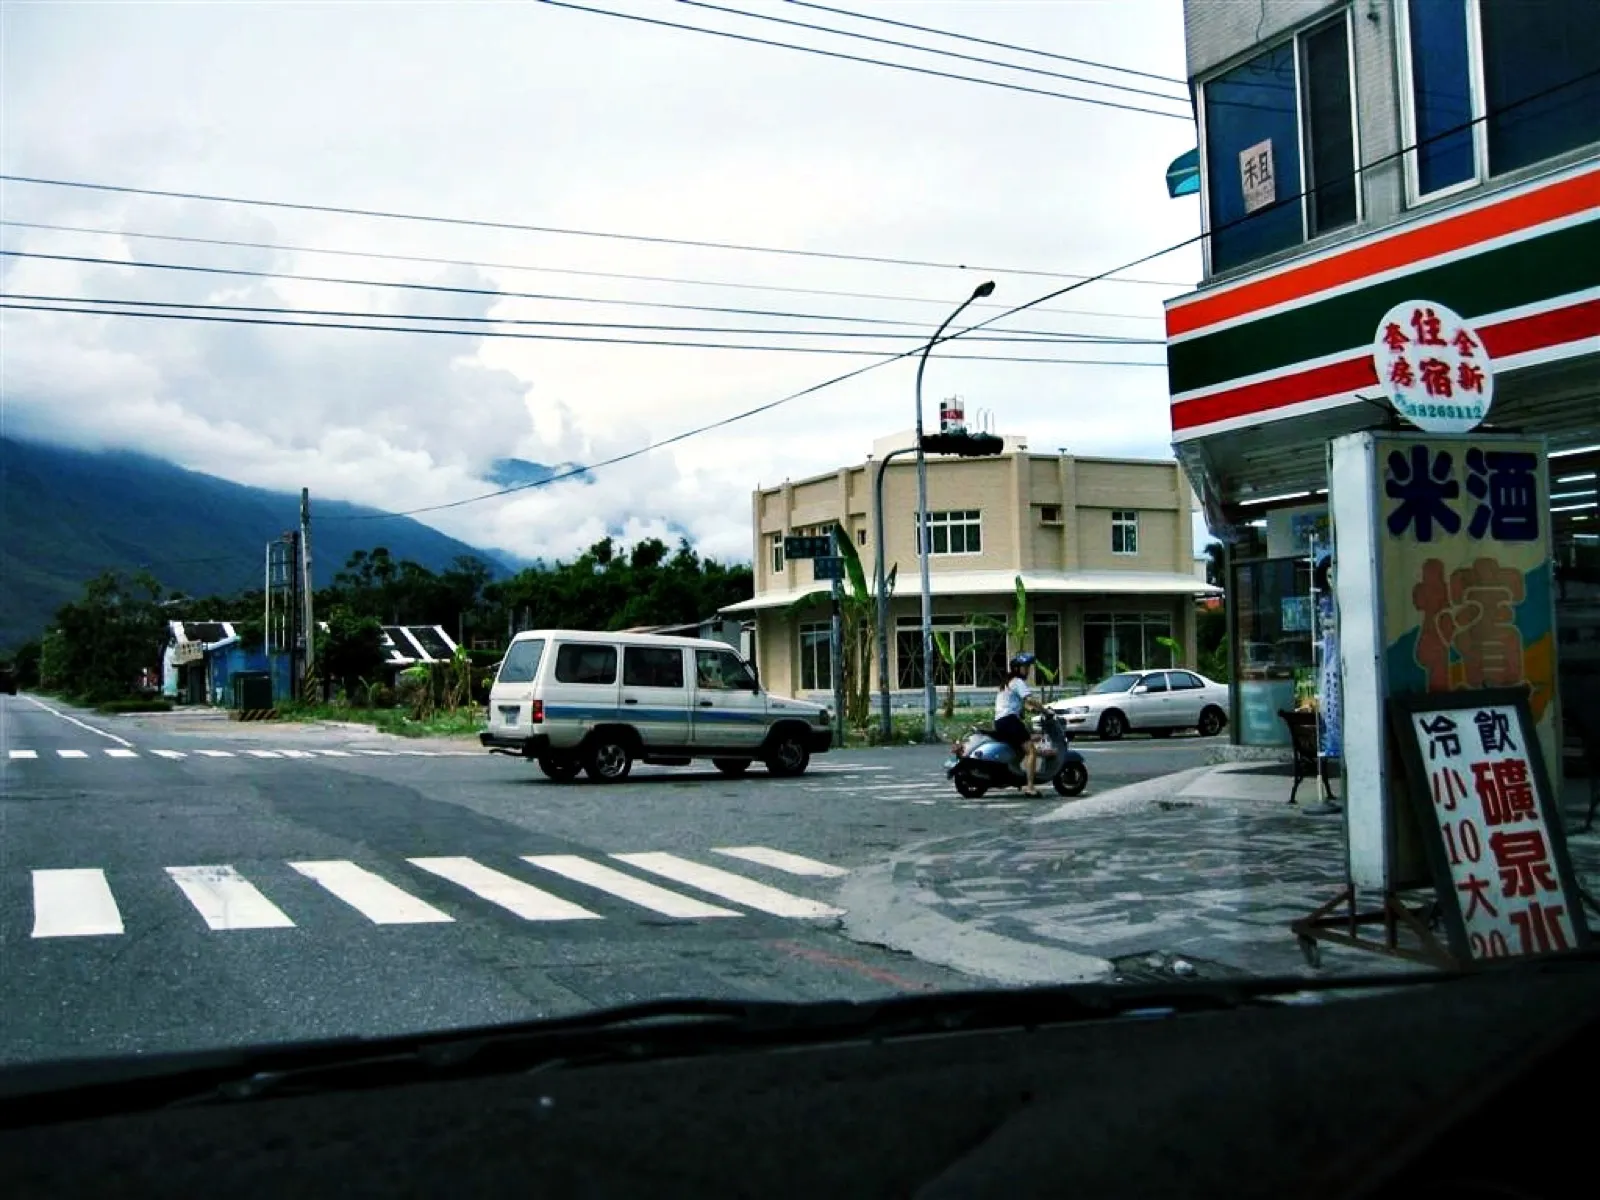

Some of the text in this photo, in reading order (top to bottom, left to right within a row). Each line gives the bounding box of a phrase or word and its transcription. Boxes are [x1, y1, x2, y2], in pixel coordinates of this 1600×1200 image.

[1244, 151, 1272, 189] 租
[1411, 308, 1452, 397] 住宿
[1453, 328, 1484, 394] 全新
[1385, 444, 1539, 542] 米酒
[1420, 709, 1516, 760] 冷飲
[1470, 758, 1568, 953] 礦泉水
